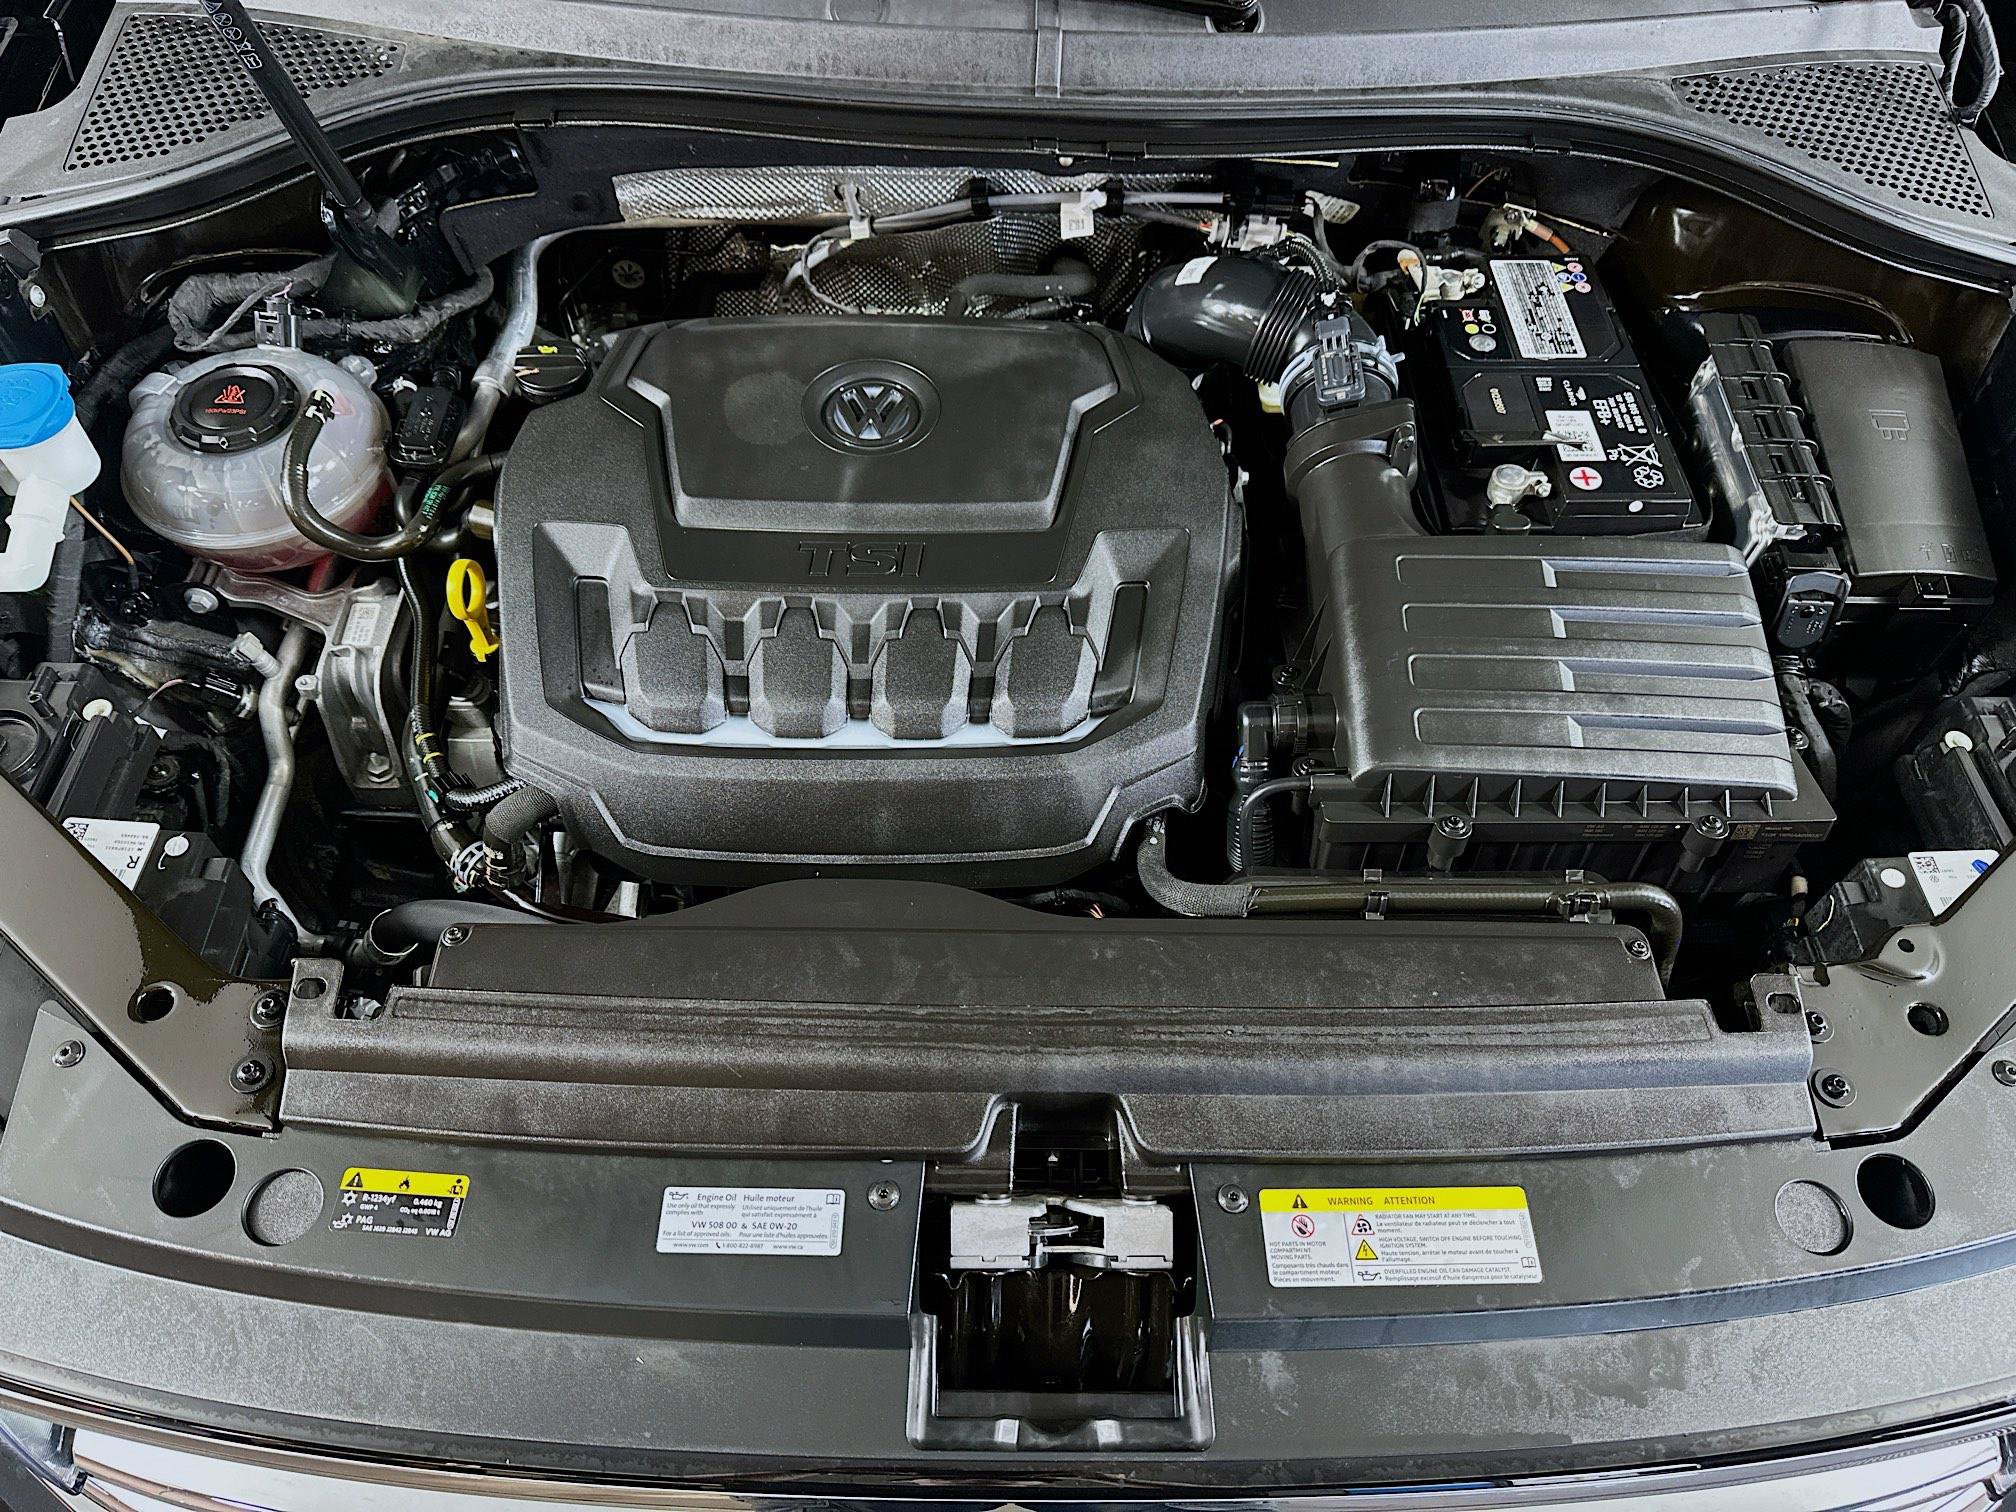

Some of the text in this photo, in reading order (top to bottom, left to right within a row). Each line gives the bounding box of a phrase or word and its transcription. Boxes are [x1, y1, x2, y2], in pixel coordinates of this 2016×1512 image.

[1562, 379, 1578, 407] CLARIOS
[1592, 399, 1612, 426] EFB+
[1606, 449, 1620, 461] Pb
[799, 541, 926, 577] TSI
[126, 855, 140, 869] R
[362, 1193, 397, 1206] R-1234yf
[434, 1199, 443, 1209] kg
[697, 1193, 737, 1203] Engine Oil
[743, 1194, 764, 1202] Huile
[1327, 1196, 1435, 1206] WARNING ATTENTION
[356, 1215, 374, 1224] PAG
[708, 1221, 724, 1229] 508
[725, 1221, 737, 1229] 00
[752, 1222, 767, 1230] SAE
[426, 1227, 452, 1237] VW AG
